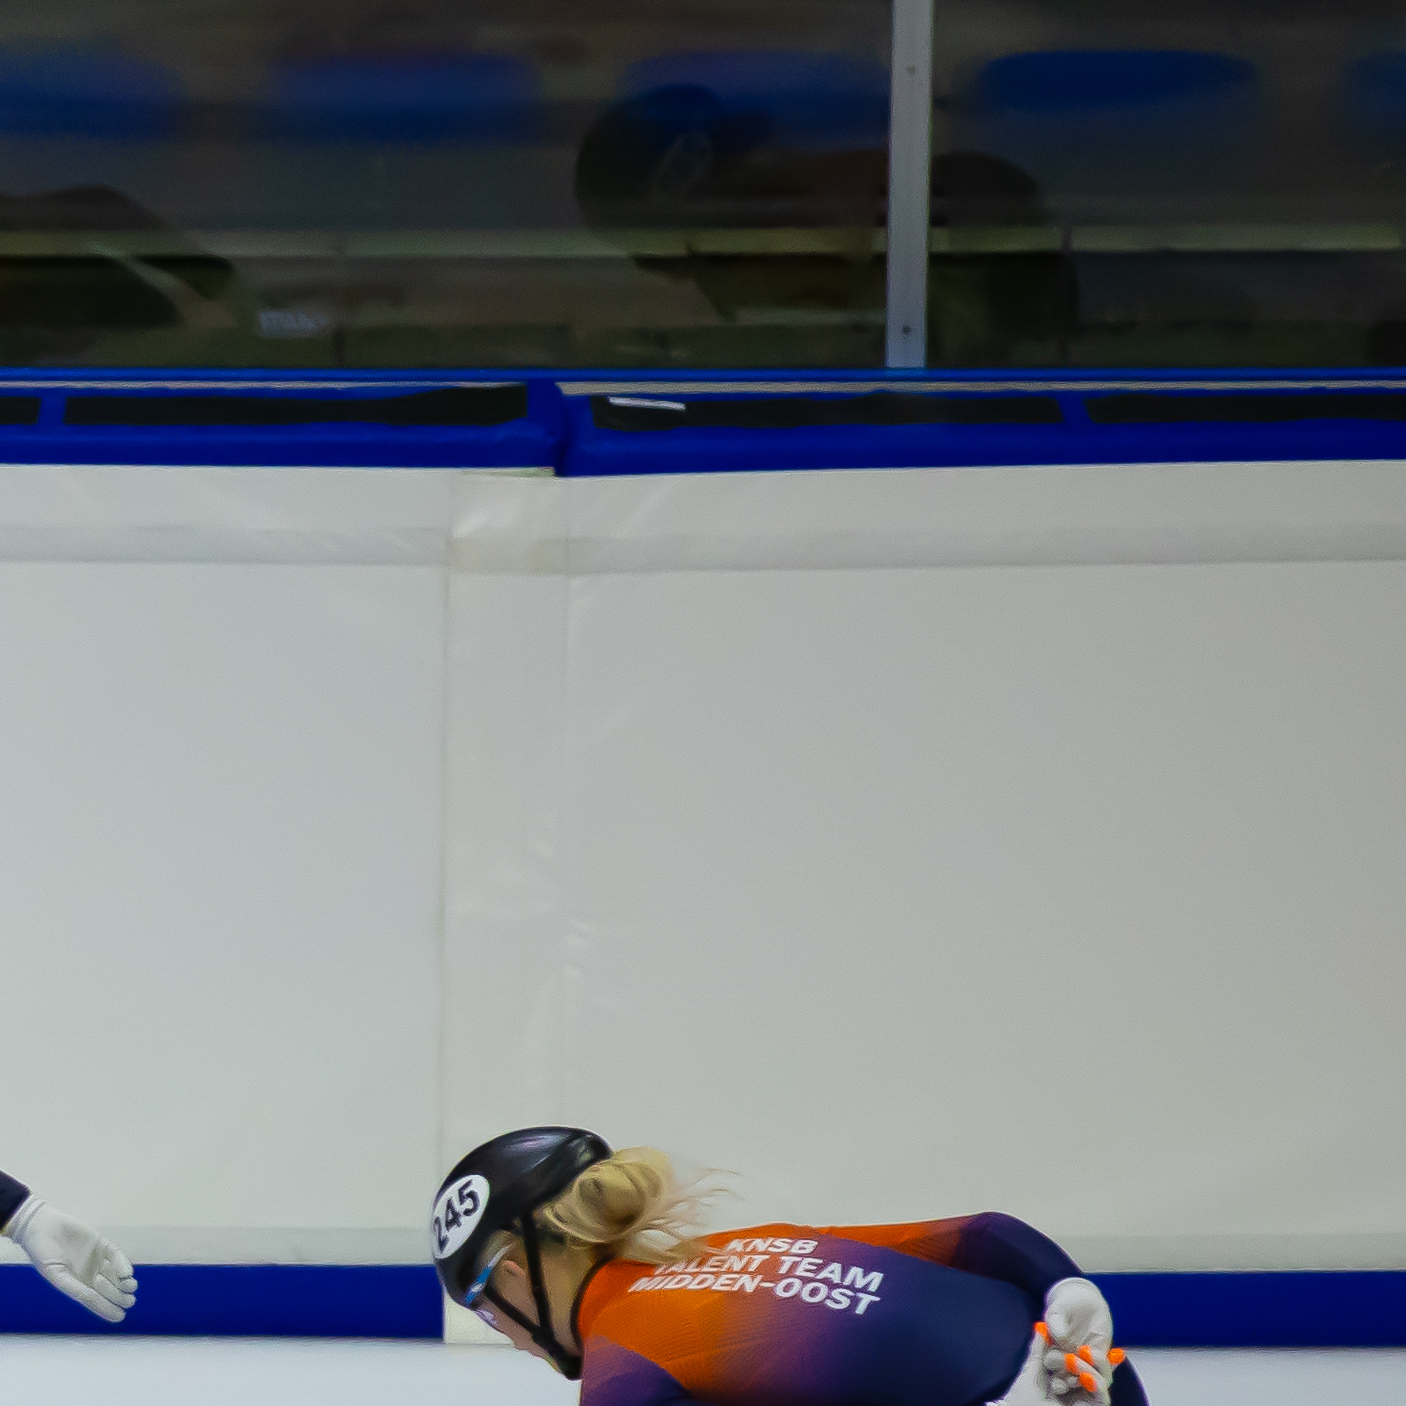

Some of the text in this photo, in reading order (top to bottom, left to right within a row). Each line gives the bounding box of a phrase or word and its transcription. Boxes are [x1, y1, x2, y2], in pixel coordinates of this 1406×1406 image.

[434, 1179, 480, 1253] 245
[725, 1237, 819, 1255] KNSB
[777, 1255, 884, 1292] TEAM
[627, 1273, 881, 1315] MIDDEN-OOST
